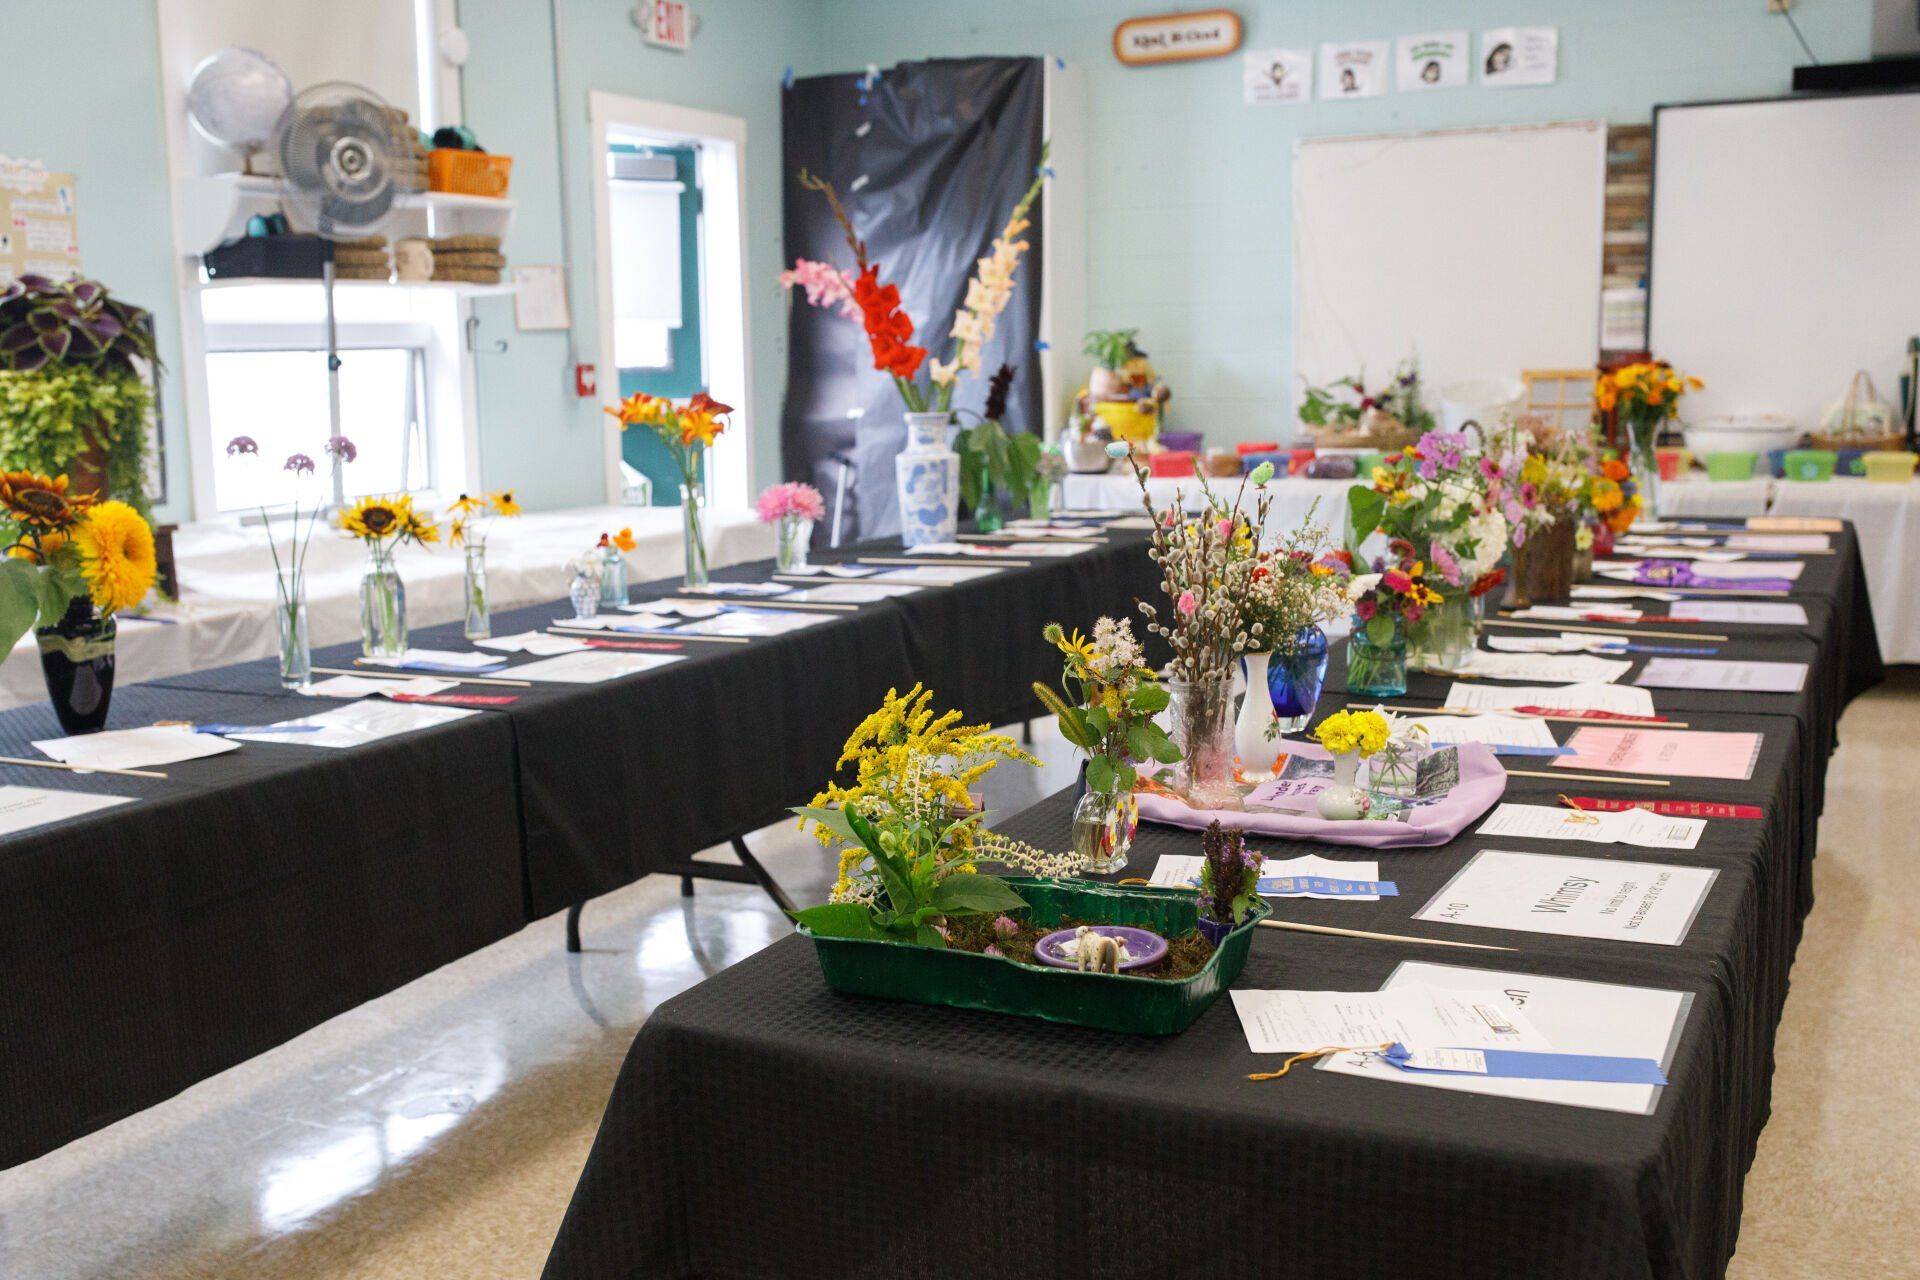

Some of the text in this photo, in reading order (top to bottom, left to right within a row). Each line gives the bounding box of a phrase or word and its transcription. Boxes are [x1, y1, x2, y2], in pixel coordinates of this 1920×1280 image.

[655, 0, 685, 43] EXIT
[1530, 875, 1600, 913] Whimsy
[1439, 902, 1470, 920] A-10
[1599, 907, 1618, 915] No
[1623, 919, 1641, 930] Not
[1634, 900, 1655, 915] exceed
[1345, 1051, 1380, 1069] A-6
